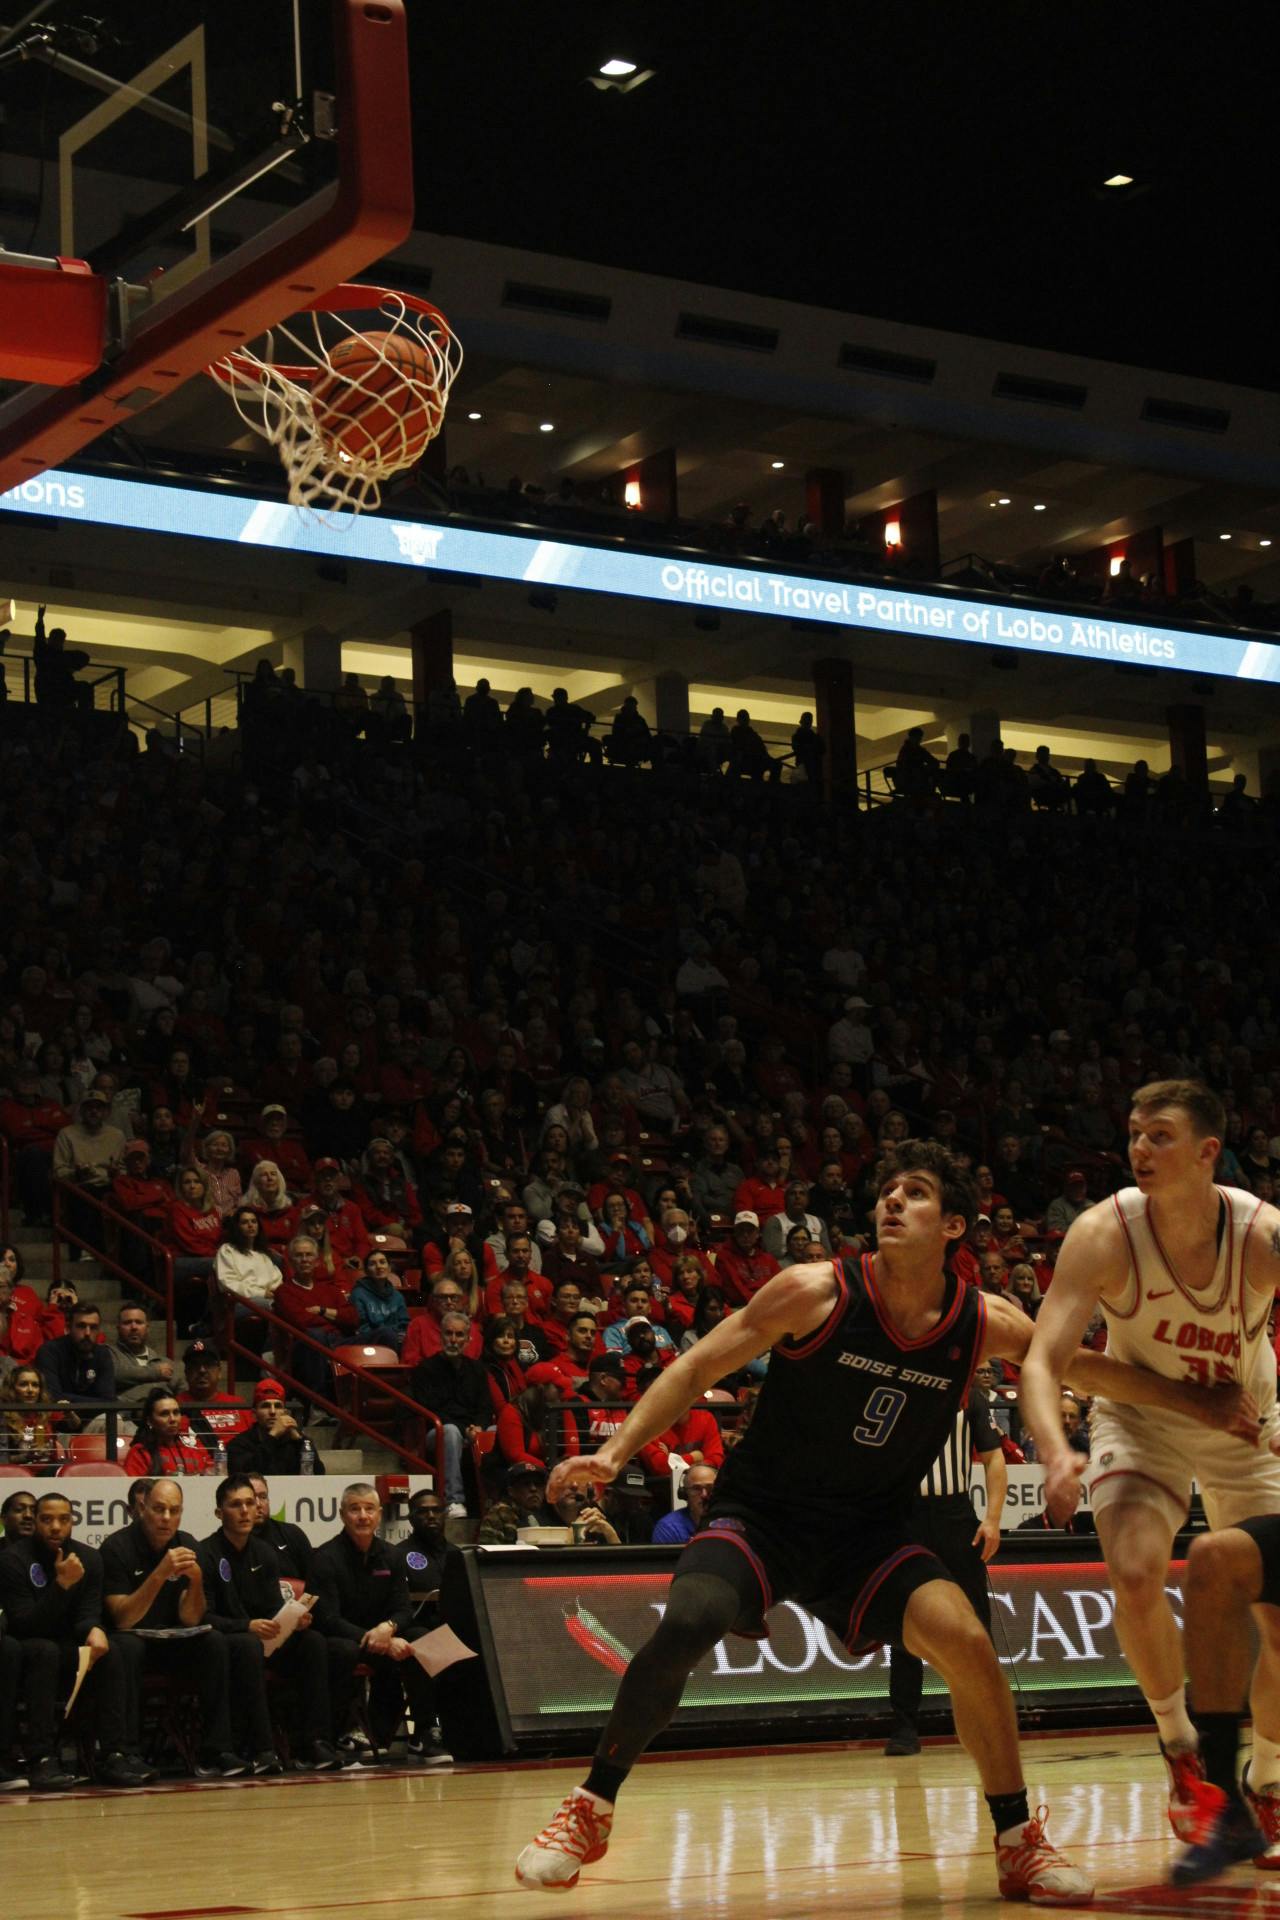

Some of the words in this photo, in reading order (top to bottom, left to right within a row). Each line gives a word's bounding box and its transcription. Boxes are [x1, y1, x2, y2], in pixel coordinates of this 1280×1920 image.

[661, 565, 762, 602] Official
[768, 578, 850, 615] Travel
[857, 591, 955, 629] Partner
[962, 610, 990, 640] of
[997, 611, 1064, 644] Lobo
[1070, 621, 1175, 659] Athletics
[837, 1351, 898, 1378] BOISE
[897, 1368, 953, 1391] STATE
[852, 1386, 907, 1447] 9
